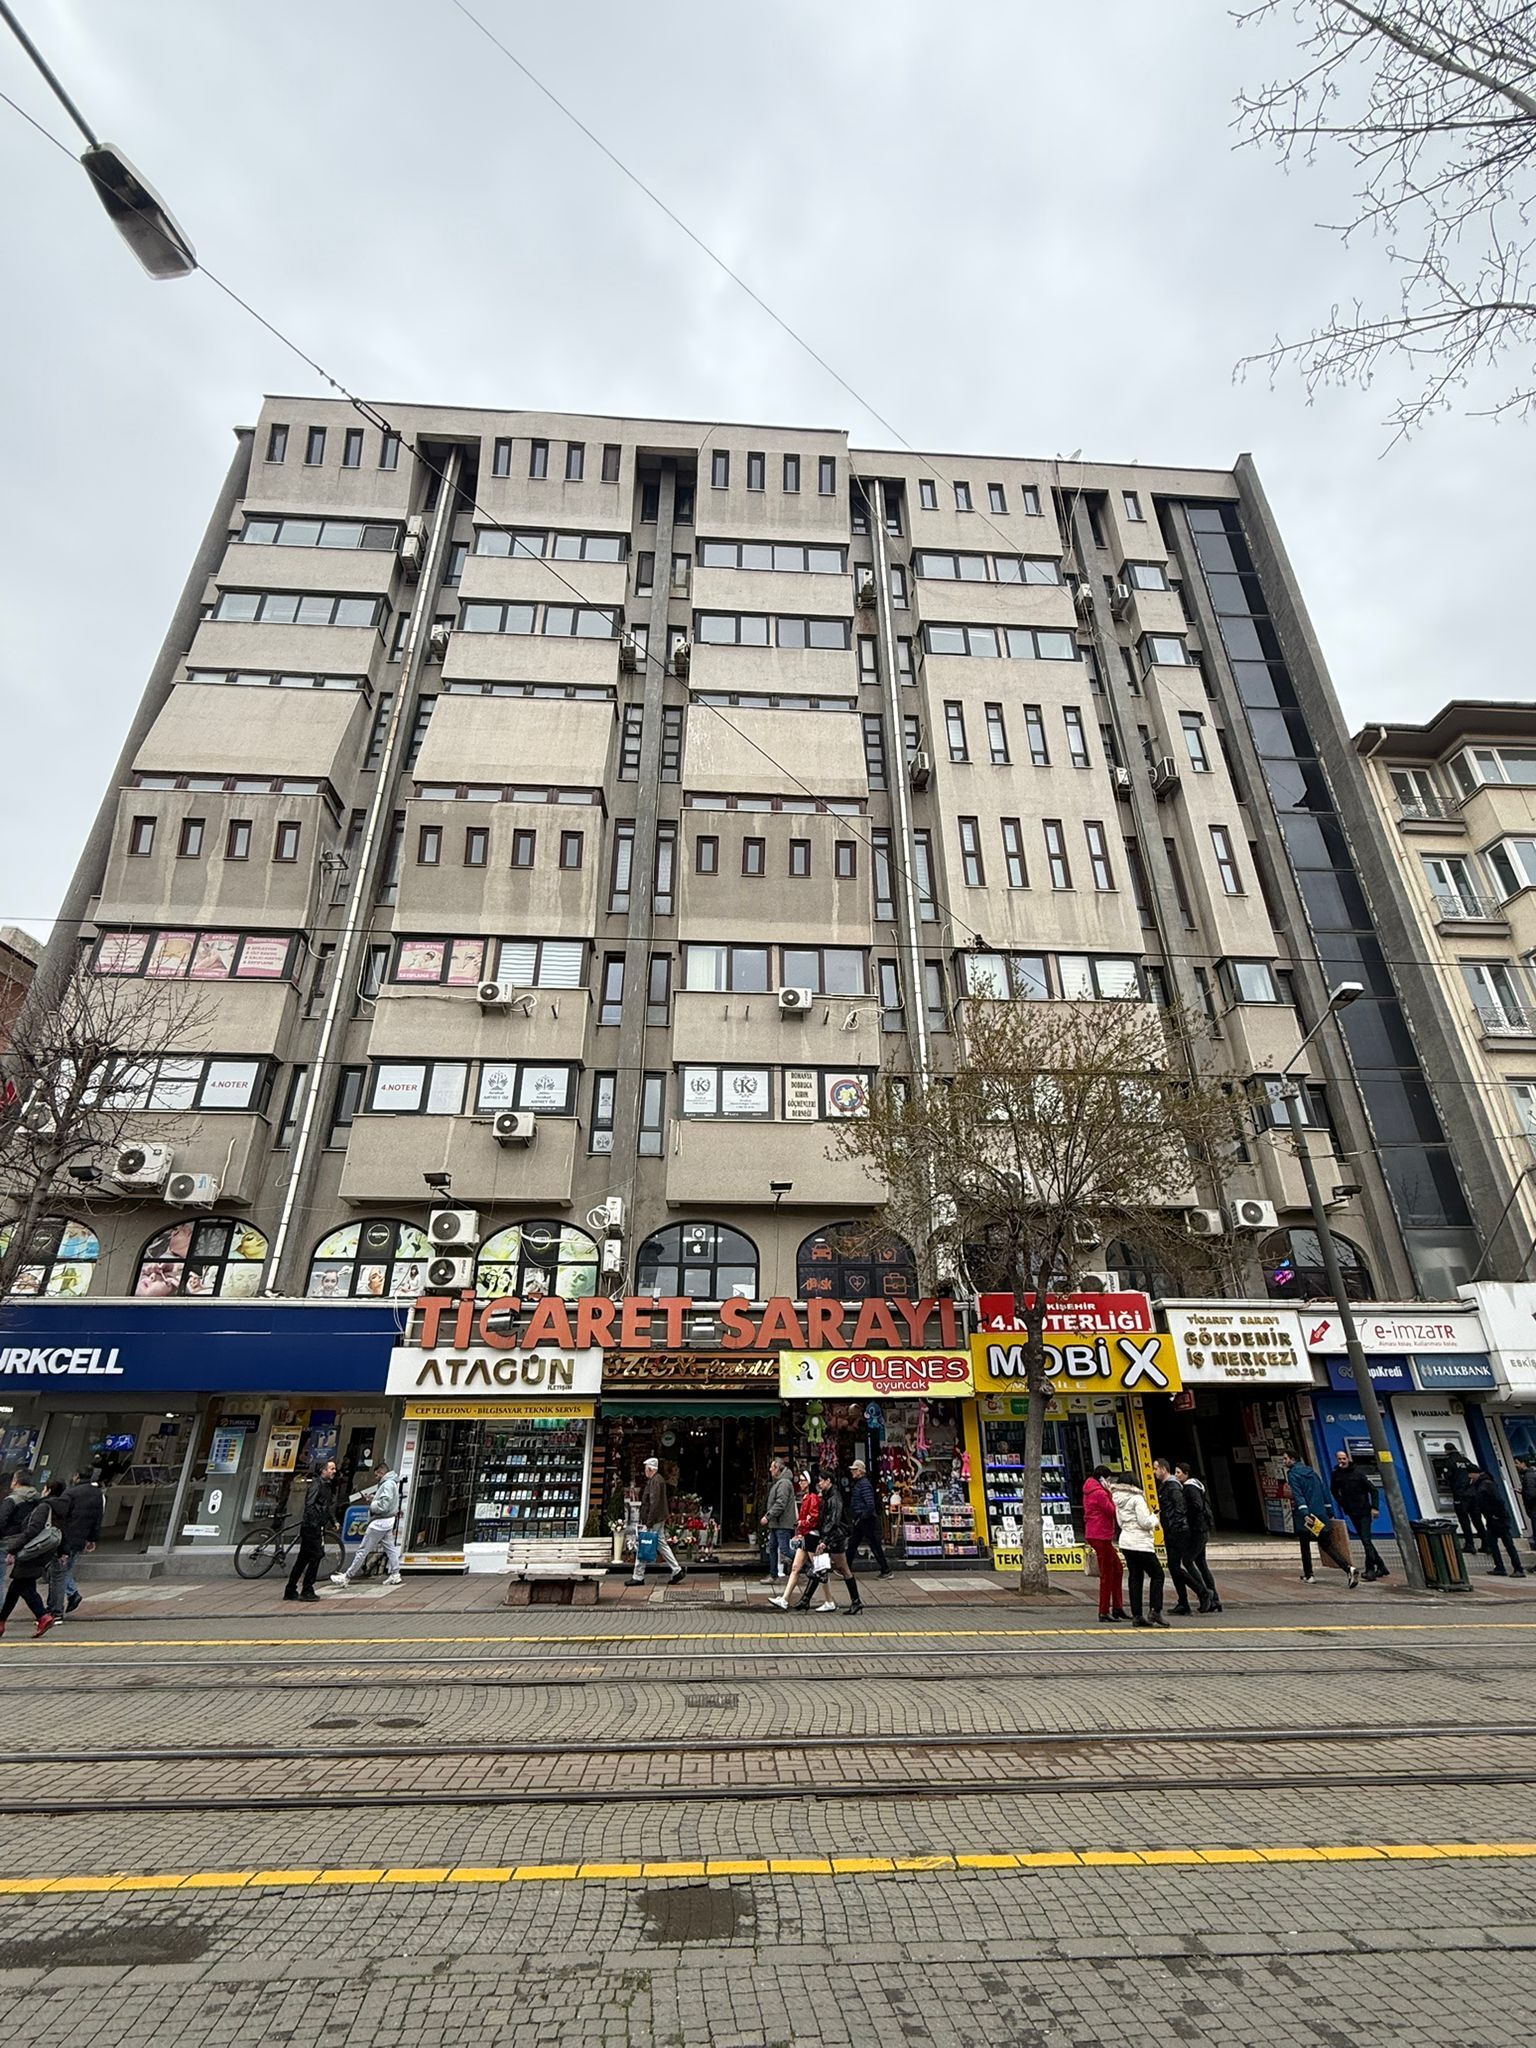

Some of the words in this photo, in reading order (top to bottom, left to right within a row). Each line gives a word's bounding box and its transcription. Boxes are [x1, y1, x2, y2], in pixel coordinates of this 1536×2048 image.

[210, 1080, 248, 1089] 4.NOTER
[380, 1083, 418, 1092] 4.NOTER
[414, 1289, 693, 1350] TİCARET
[719, 1296, 958, 1350] SARAYI
[1186, 1314, 1233, 1325] TİCARET
[1239, 1316, 1280, 1325] SARAYI
[1183, 1327, 1293, 1347] GÖKDEMİR
[1374, 1320, 1456, 1339] e-imzaTR
[830, 1355, 964, 1380] GÜLENES
[1117, 1337, 1170, 1389] X
[1186, 1348, 1205, 1369] İŞ
[1211, 1348, 1299, 1367] MERKEZİ
[416, 1354, 575, 1386] ATAGÜN
[1433, 1366, 1491, 1377] HALKBANK
[876, 1380, 927, 1391] oyuncak
[415, 1407, 431, 1415] CEP
[477, 1405, 522, 1414] BİLGİSAYAR
[524, 1405, 553, 1414] TEKNİK
[555, 1405, 581, 1413] SERVİS
